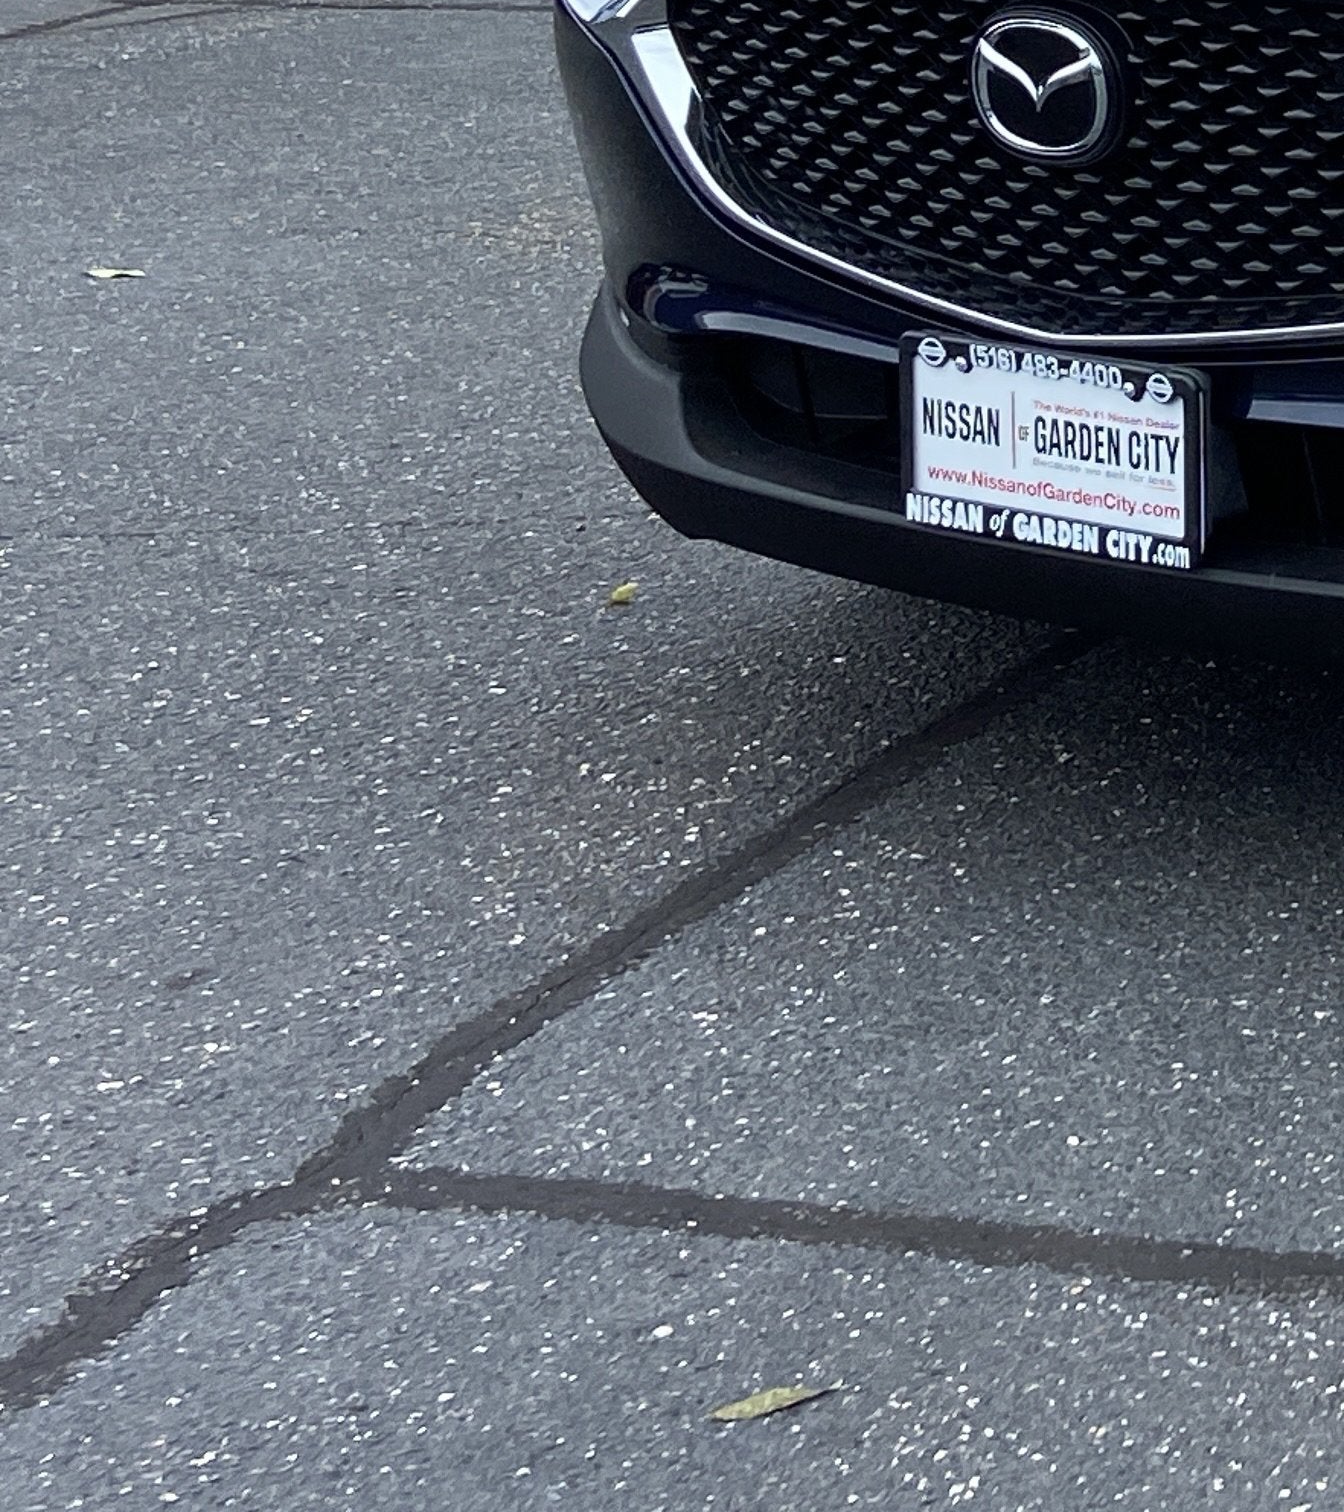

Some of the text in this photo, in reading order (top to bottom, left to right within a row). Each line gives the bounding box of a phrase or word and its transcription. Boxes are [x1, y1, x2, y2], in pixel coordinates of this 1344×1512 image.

[969, 343, 1017, 373] (516)
[1021, 352, 1123, 389] 483-4400
[923, 396, 1000, 446] NISSAN
[1034, 415, 1120, 466] GARDEN
[1128, 430, 1180, 474] CITY
[1033, 400, 1052, 412] The
[1055, 405, 1091, 418] World's
[1107, 412, 1144, 426] Nissan
[1145, 417, 1180, 430] Dealer
[1032, 457, 1081, 473] Because
[928, 465, 1180, 520] www.NissanofGardenCity.com
[906, 492, 1190, 569] NISSAN of GARDEN CITY.com
